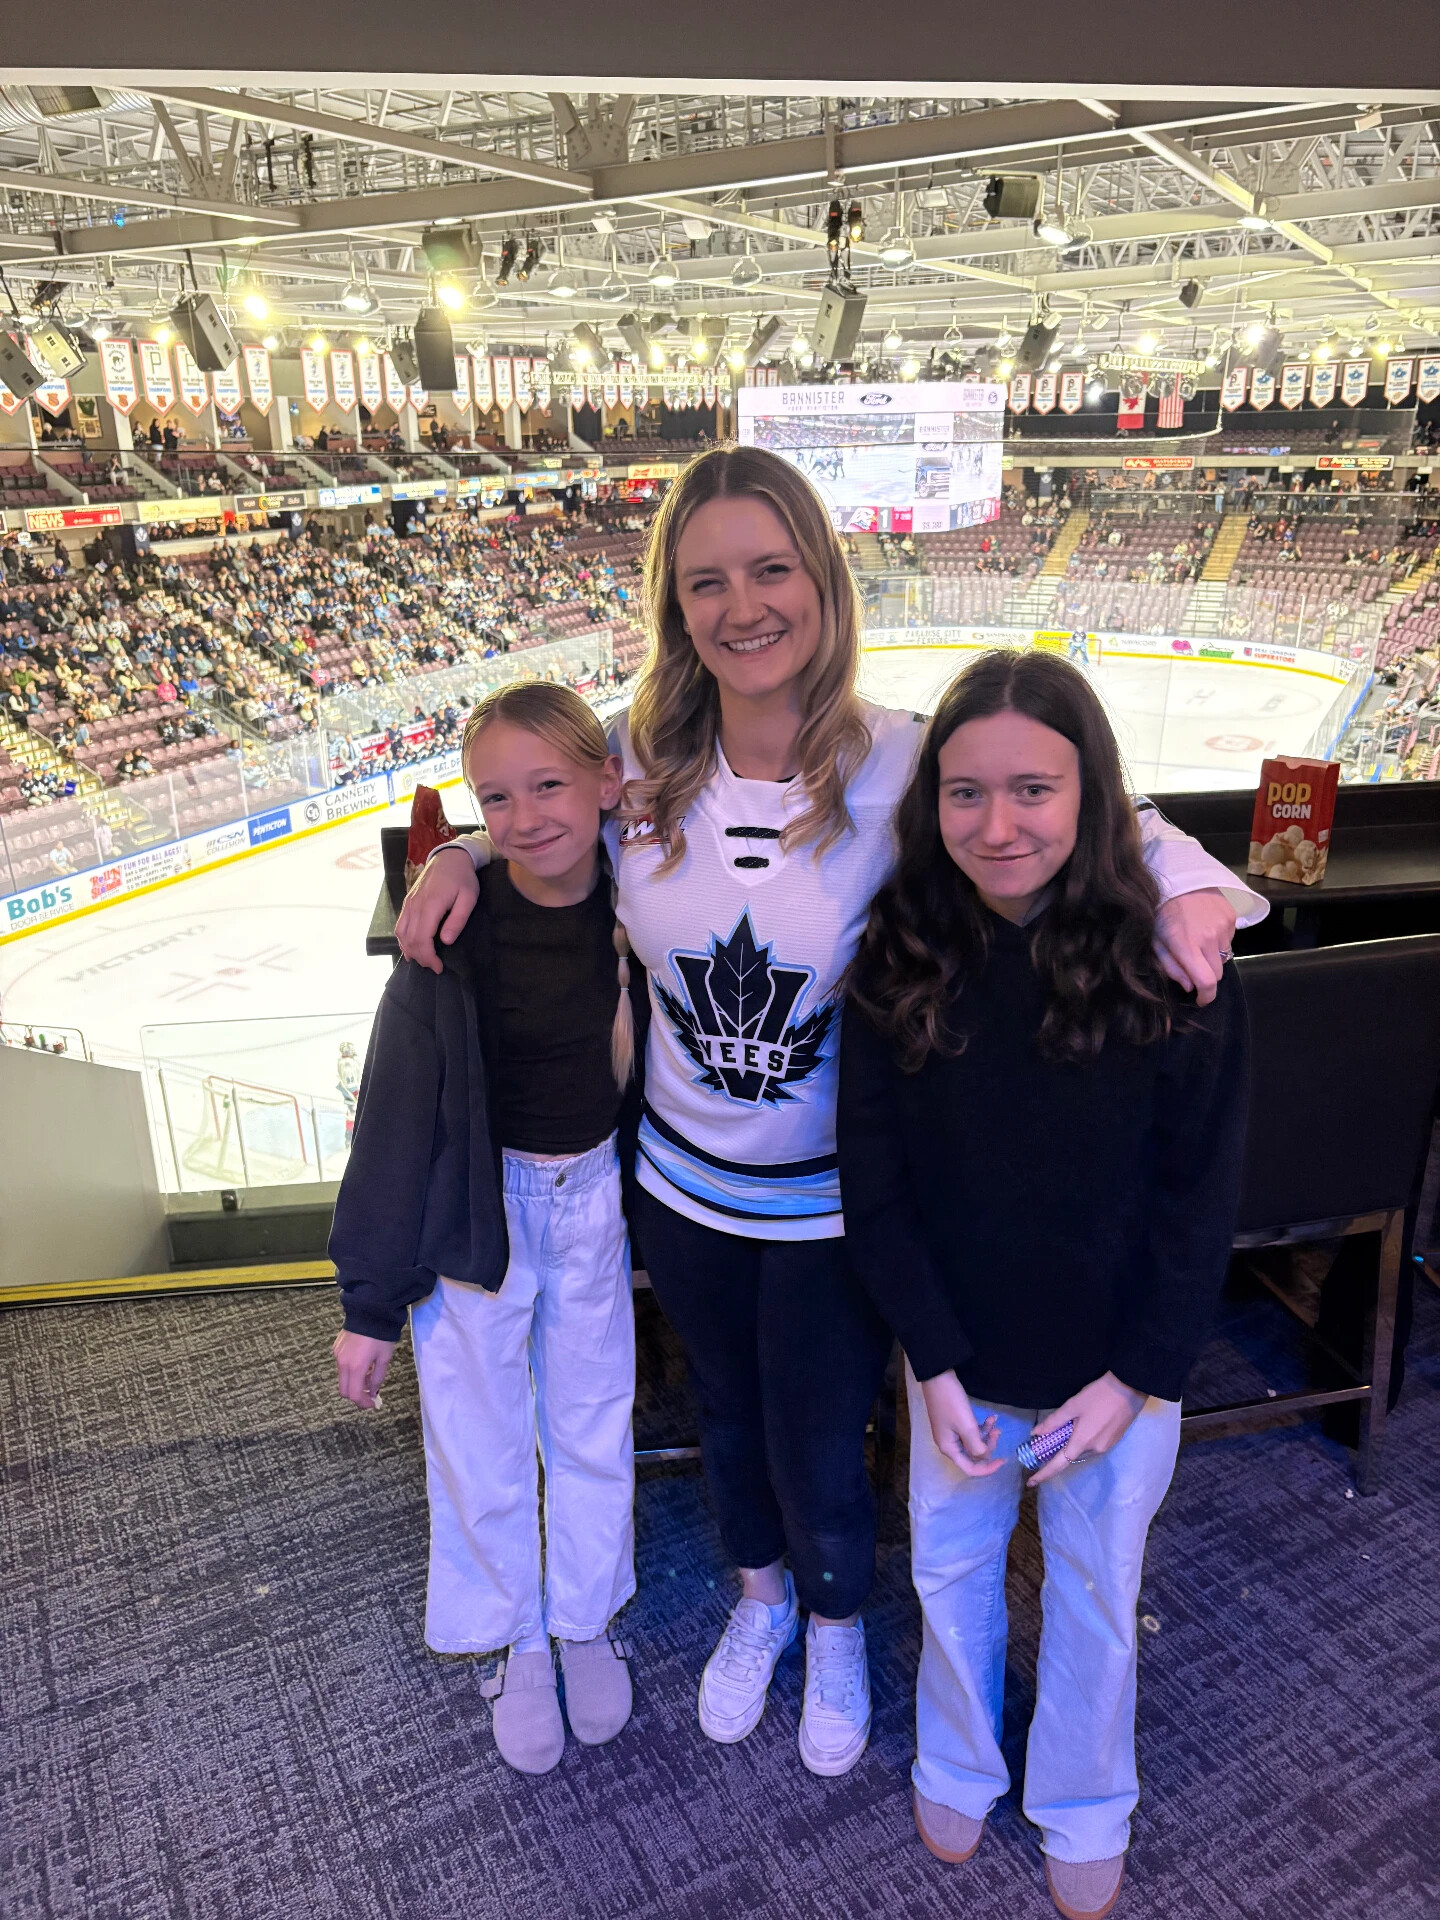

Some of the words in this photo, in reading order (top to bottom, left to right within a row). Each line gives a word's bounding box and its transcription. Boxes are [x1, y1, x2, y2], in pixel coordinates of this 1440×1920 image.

[782, 391, 844, 405] BANNISTER
[862, 392, 891, 406] Ford
[28, 513, 65, 529] NEWS
[1254, 653, 1296, 664] SUPERSTORE
[325, 782, 376, 806] CANNERY
[1267, 782, 1311, 806] POP
[326, 796, 377, 820] BREWING
[1272, 803, 1311, 819] CORN
[253, 818, 287, 836] PENTICTON
[206, 837, 246, 855] COLLISION
[124, 861, 137, 871] FUN
[138, 856, 150, 866] FOR
[151, 852, 162, 862] ALL
[6, 885, 73, 921] Bob's
[10, 915, 38, 931] DOOR
[39, 903, 75, 922] SERVICE
